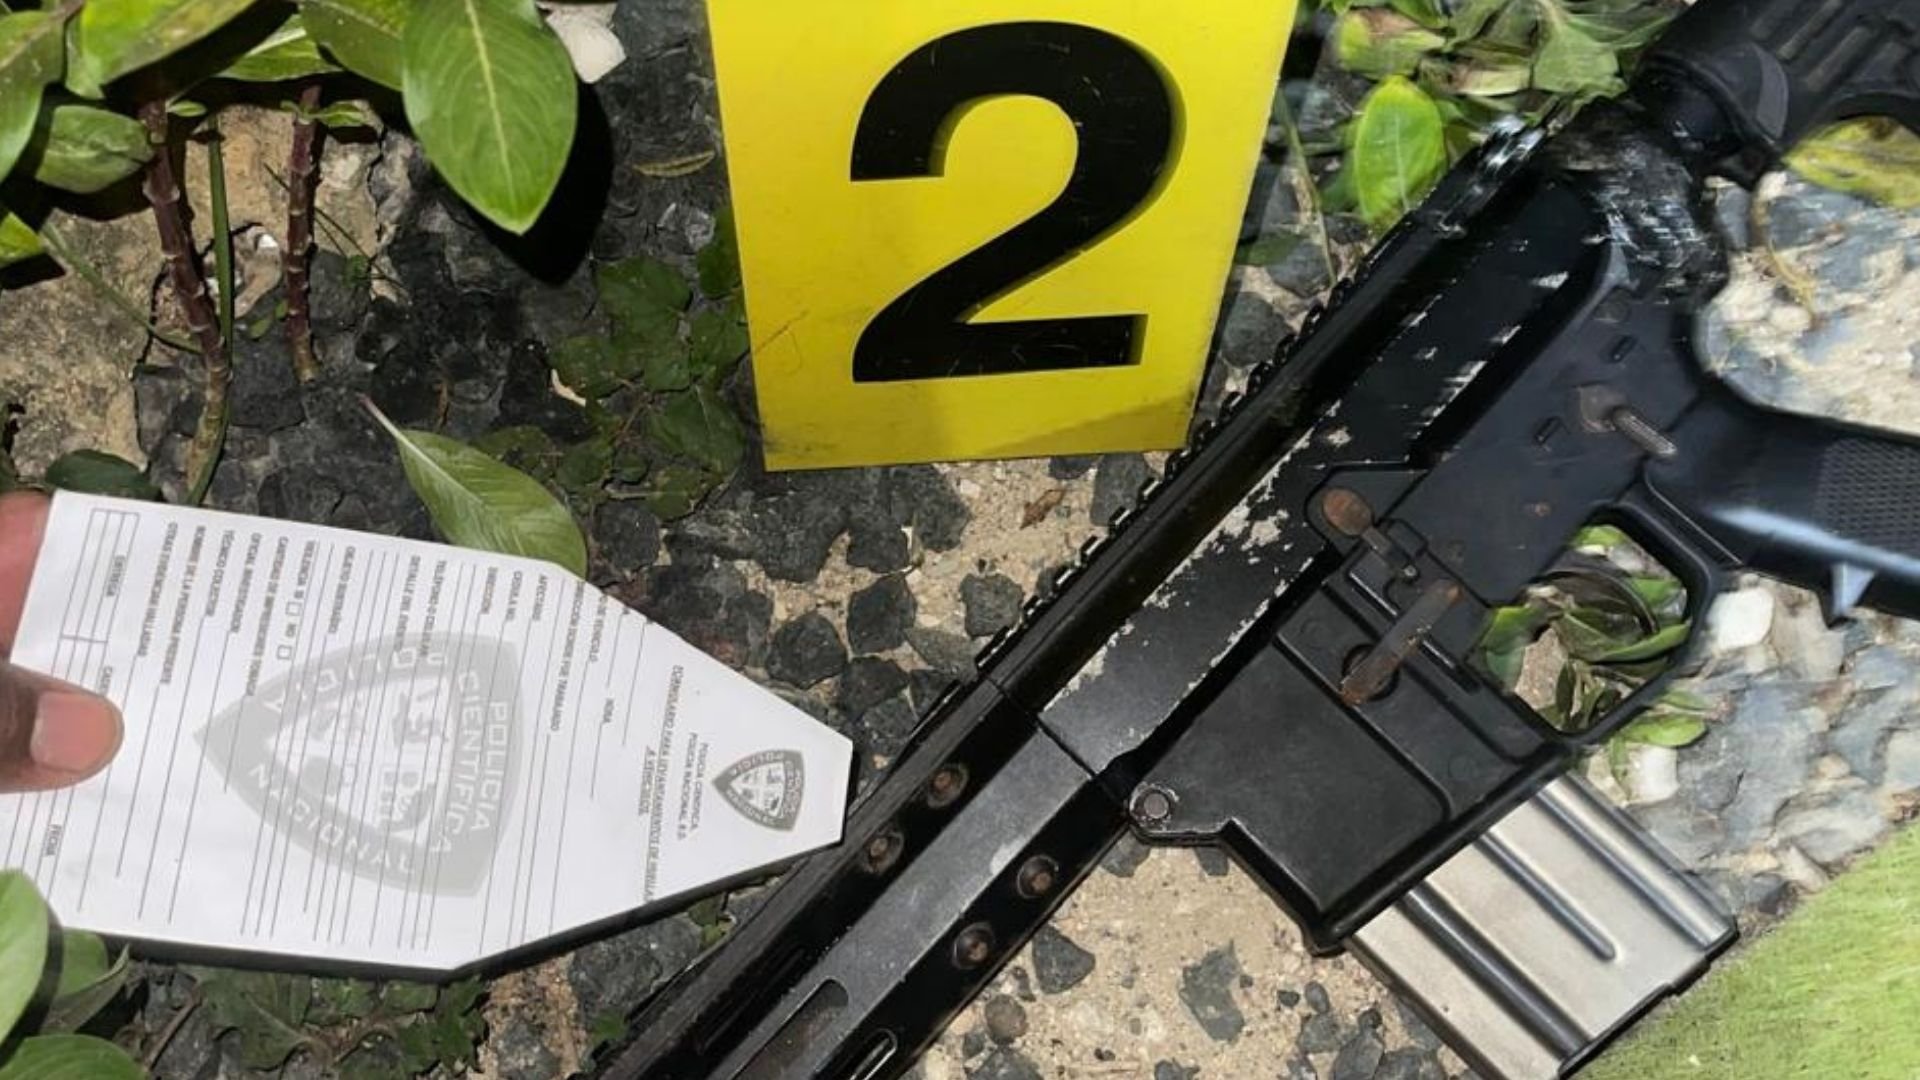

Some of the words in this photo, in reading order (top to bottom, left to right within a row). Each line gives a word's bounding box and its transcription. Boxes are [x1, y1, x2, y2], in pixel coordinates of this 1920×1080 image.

[850, 21, 1187, 383] 2
[162, 521, 178, 553] OTRAS
[188, 524, 205, 564] NOMBRE
[245, 531, 261, 567] OFICIAL
[270, 535, 287, 580] CANTIDAD
[105, 554, 125, 599] ENTREGA
[296, 538, 315, 586] VIOLENCIA
[339, 545, 355, 582] OBJETO
[404, 554, 420, 594] DETALLE
[171, 591, 190, 634] PERSONA
[204, 568, 225, 618] COLECTOR
[229, 566, 253, 634] INVESTIGADOR
[401, 594, 412, 613] DEL
[285, 622, 296, 638] NO
[563, 627, 576, 659] DONDE
[159, 634, 180, 685] PRESENTE
[559, 659, 570, 678] FUE
[549, 678, 567, 732] TRABAJADO
[665, 663, 683, 730] FORMULARIO
[429, 670, 478, 852] CIENTIFICA
[661, 729, 674, 757] PARA
[685, 731, 698, 770] POLICIA
[696, 741, 708, 779] POLICIA
[469, 702, 508, 831] POLICIA
[650, 756, 671, 846] LEVANTAMIENTOS
[678, 769, 692, 819] NACIONAL
